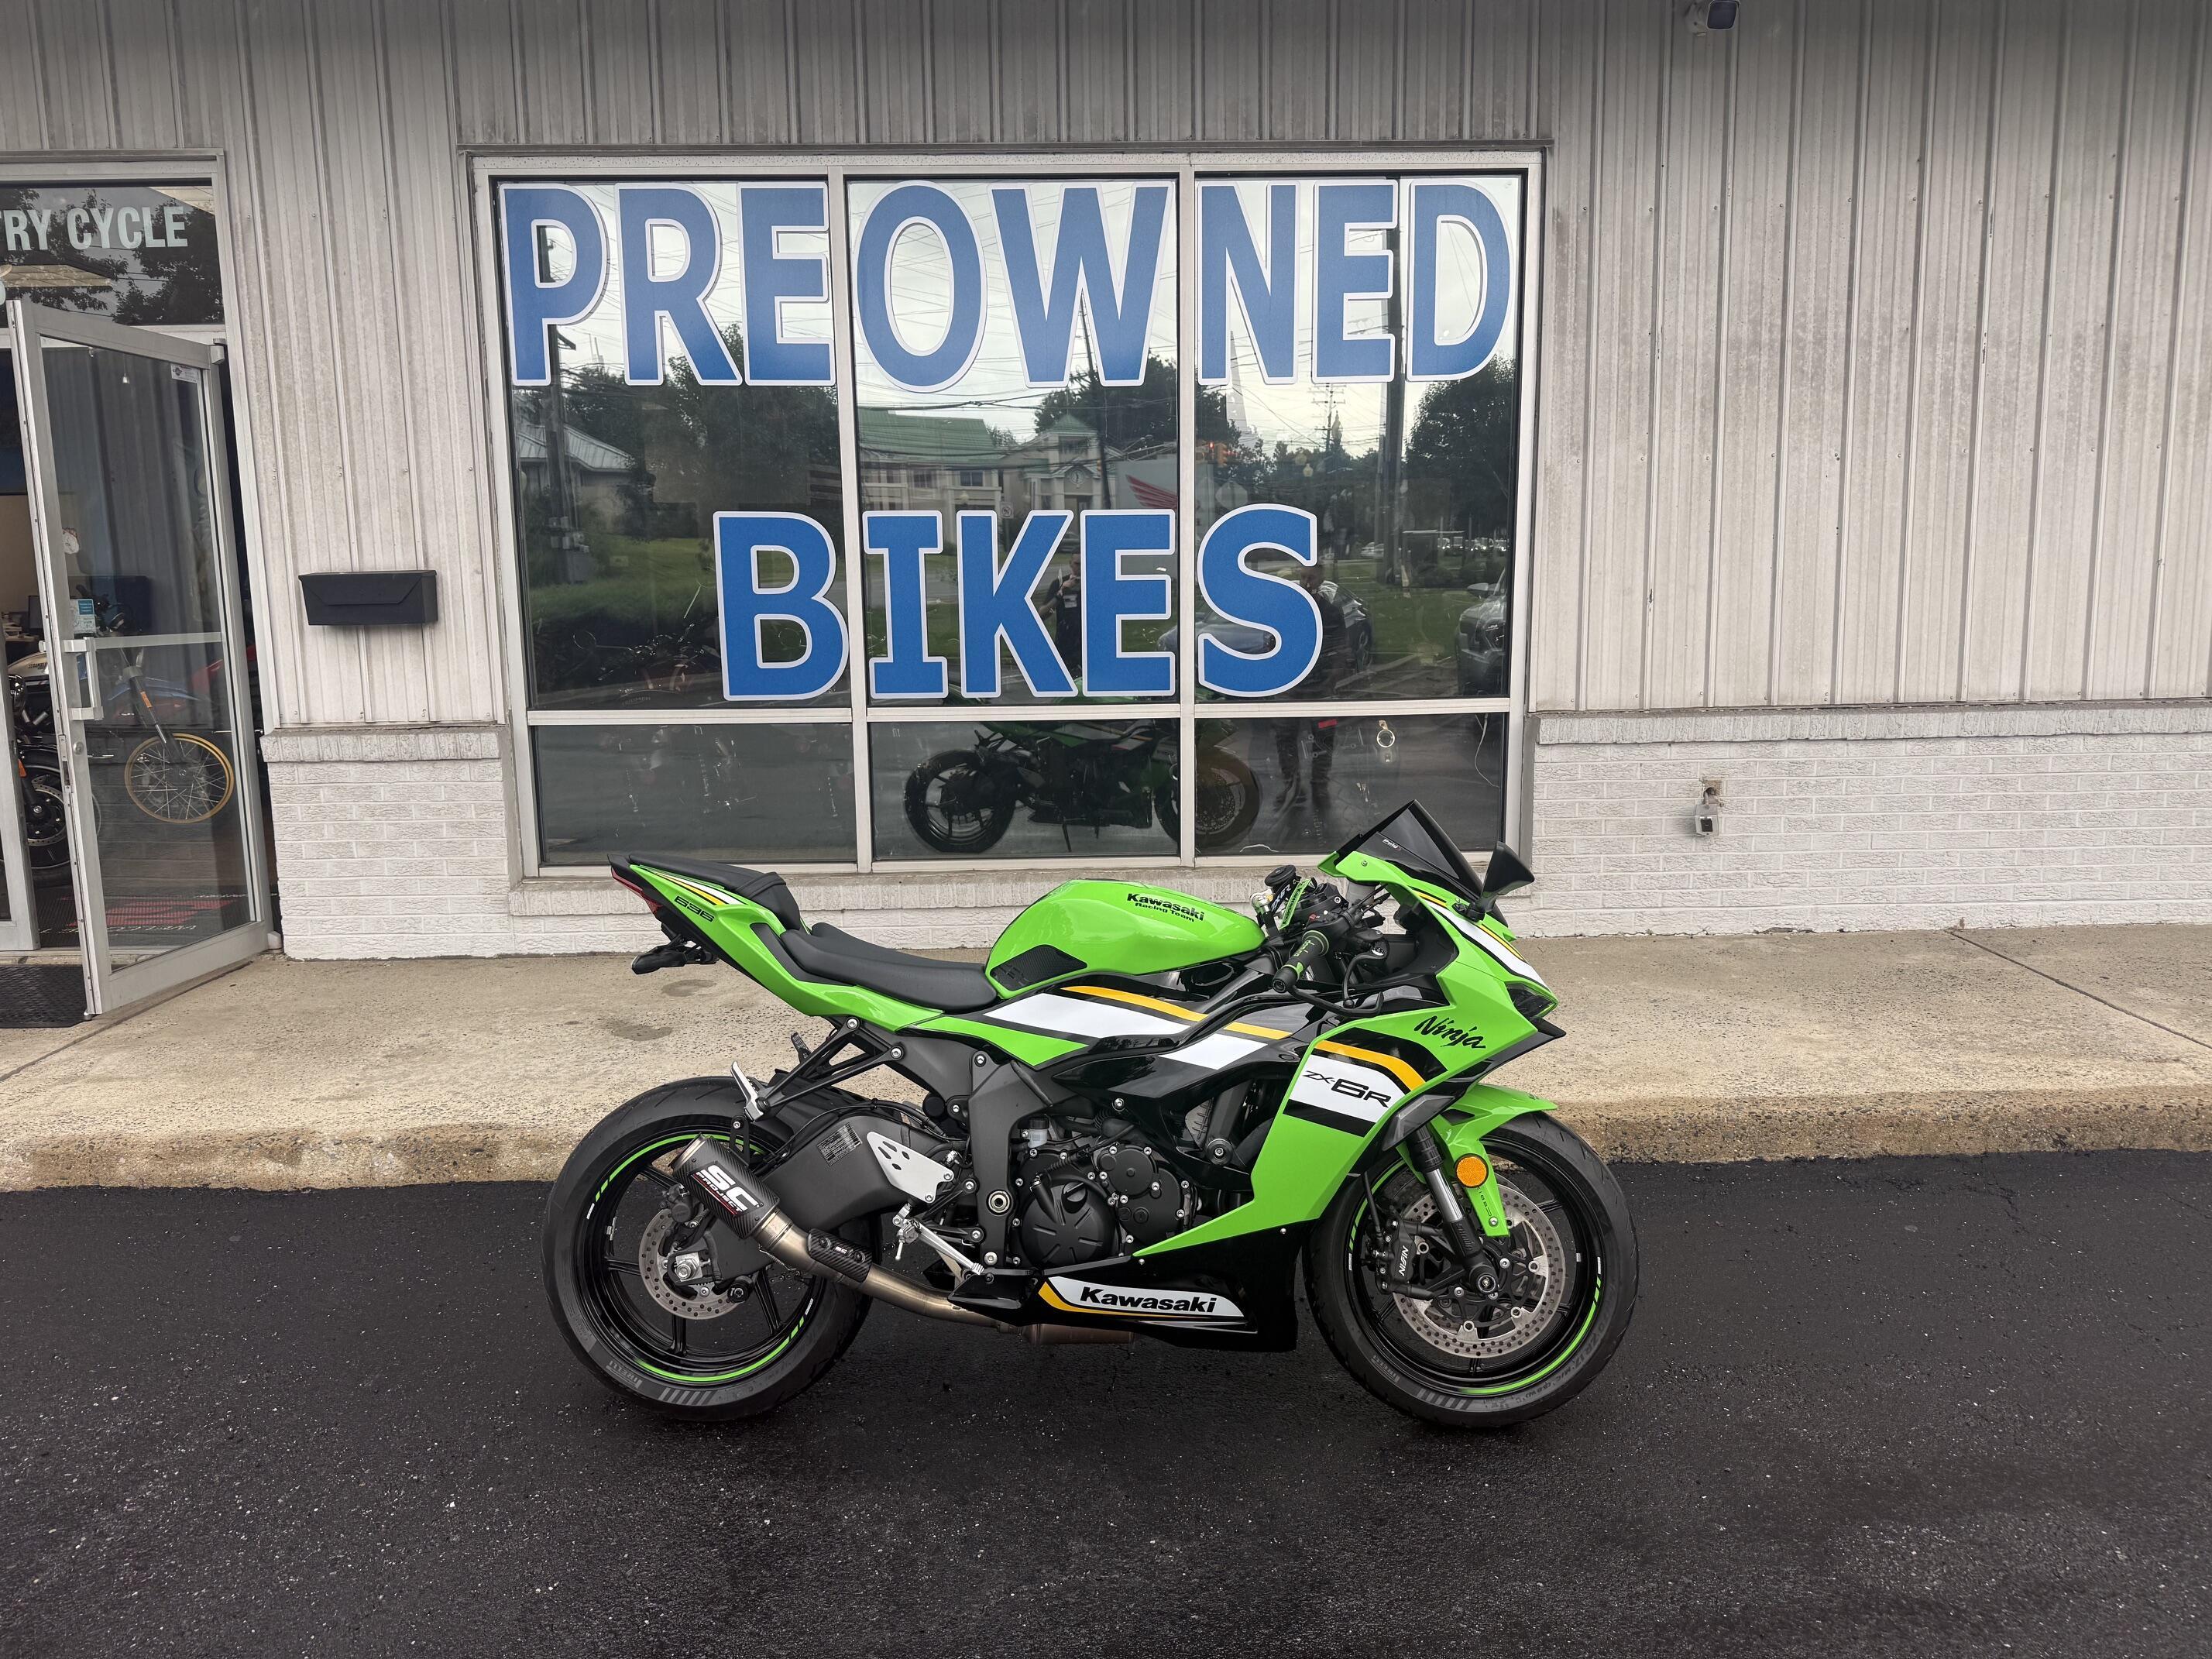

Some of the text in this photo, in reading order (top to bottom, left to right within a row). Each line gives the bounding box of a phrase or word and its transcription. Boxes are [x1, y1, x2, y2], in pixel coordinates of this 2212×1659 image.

[0, 206, 188, 251] RY CYCLE
[500, 179, 1515, 392] PREOWNED
[713, 503, 1323, 701] BIKES
[674, 895, 715, 922] 636
[1127, 893, 1205, 921] Kawasaki
[1135, 902, 1194, 922] Racing Team
[1413, 1015, 1486, 1049] Ninja
[1302, 1070, 1392, 1108] ZX-6R
[696, 1171, 743, 1212] PROJECT
[700, 1165, 759, 1211] SC
[1080, 1286, 1217, 1313] Kawasaki
